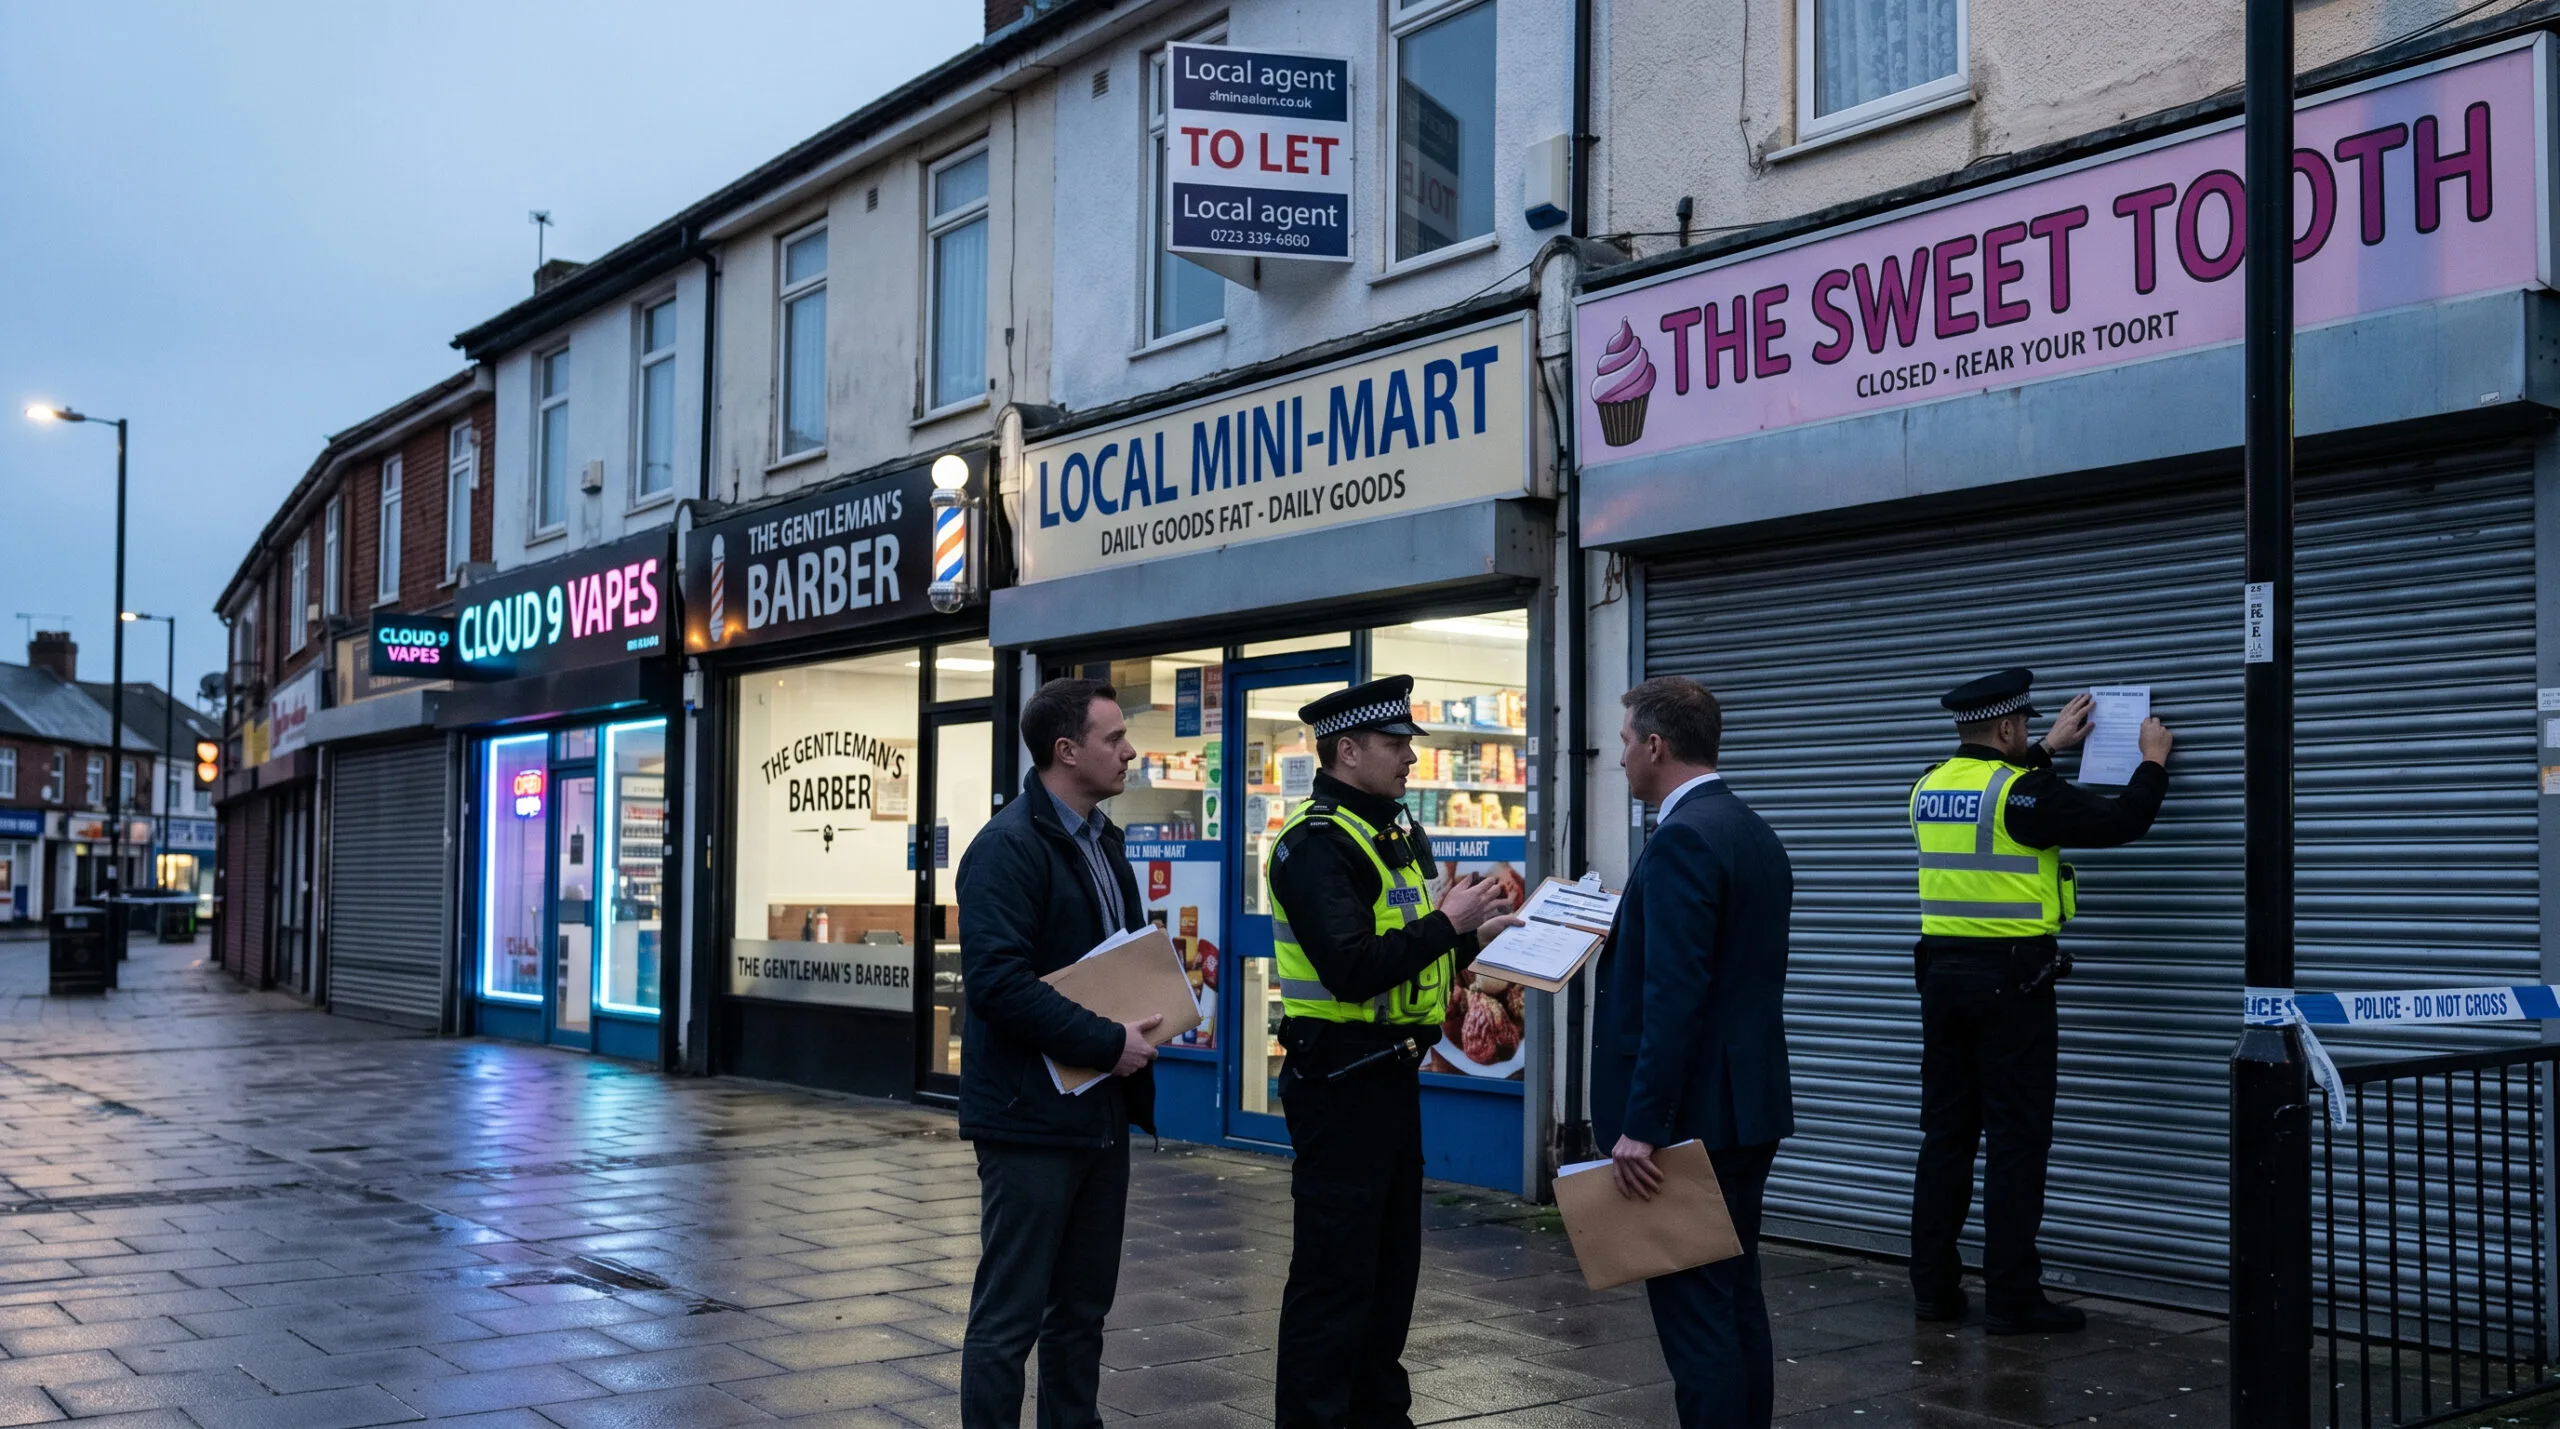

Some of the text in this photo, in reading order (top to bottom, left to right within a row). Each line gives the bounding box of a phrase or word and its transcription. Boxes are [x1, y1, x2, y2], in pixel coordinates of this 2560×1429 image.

[1185, 55, 1336, 93] Local agent
[1180, 127, 1339, 176] TO LET
[1184, 194, 1338, 230] Local agent
[1211, 229, 1244, 243] 0723
[1660, 100, 2494, 396] THE SWEET TOOTH
[1855, 361, 1938, 399] CLOSED
[1955, 342, 2015, 380] REAR
[2021, 331, 2086, 366] YOUR
[2093, 309, 2180, 352] TOORT
[1039, 345, 1499, 530] LOCAL MINI-MART
[748, 489, 903, 555] THE GENTLEMAN'S
[1101, 522, 1149, 557] DAILY
[1152, 508, 1215, 545] GOODS
[1220, 501, 1253, 533] FAT
[1269, 485, 1326, 523] DAILY
[1330, 468, 1407, 511] GOODS
[747, 533, 901, 630] BARBER
[458, 558, 659, 662] CLOUD 9 VAPES
[378, 627, 437, 646] CLOUD
[387, 645, 440, 663] VAPES
[438, 631, 450, 647] 9
[761, 730, 906, 785] THE GENTLEMAN'S
[789, 774, 872, 813] BARBER
[1917, 795, 1979, 818] POLICE
[1142, 844, 1186, 858] MINI-MART
[1432, 841, 1490, 857] MINI-MART
[737, 956, 910, 989] THE GENTLEMAN'S BARBER
[2355, 996, 2401, 1019] POLICE
[2414, 995, 2432, 1018] DO
[2436, 994, 2461, 1017] NOT
[2465, 993, 2507, 1016] CROSS
